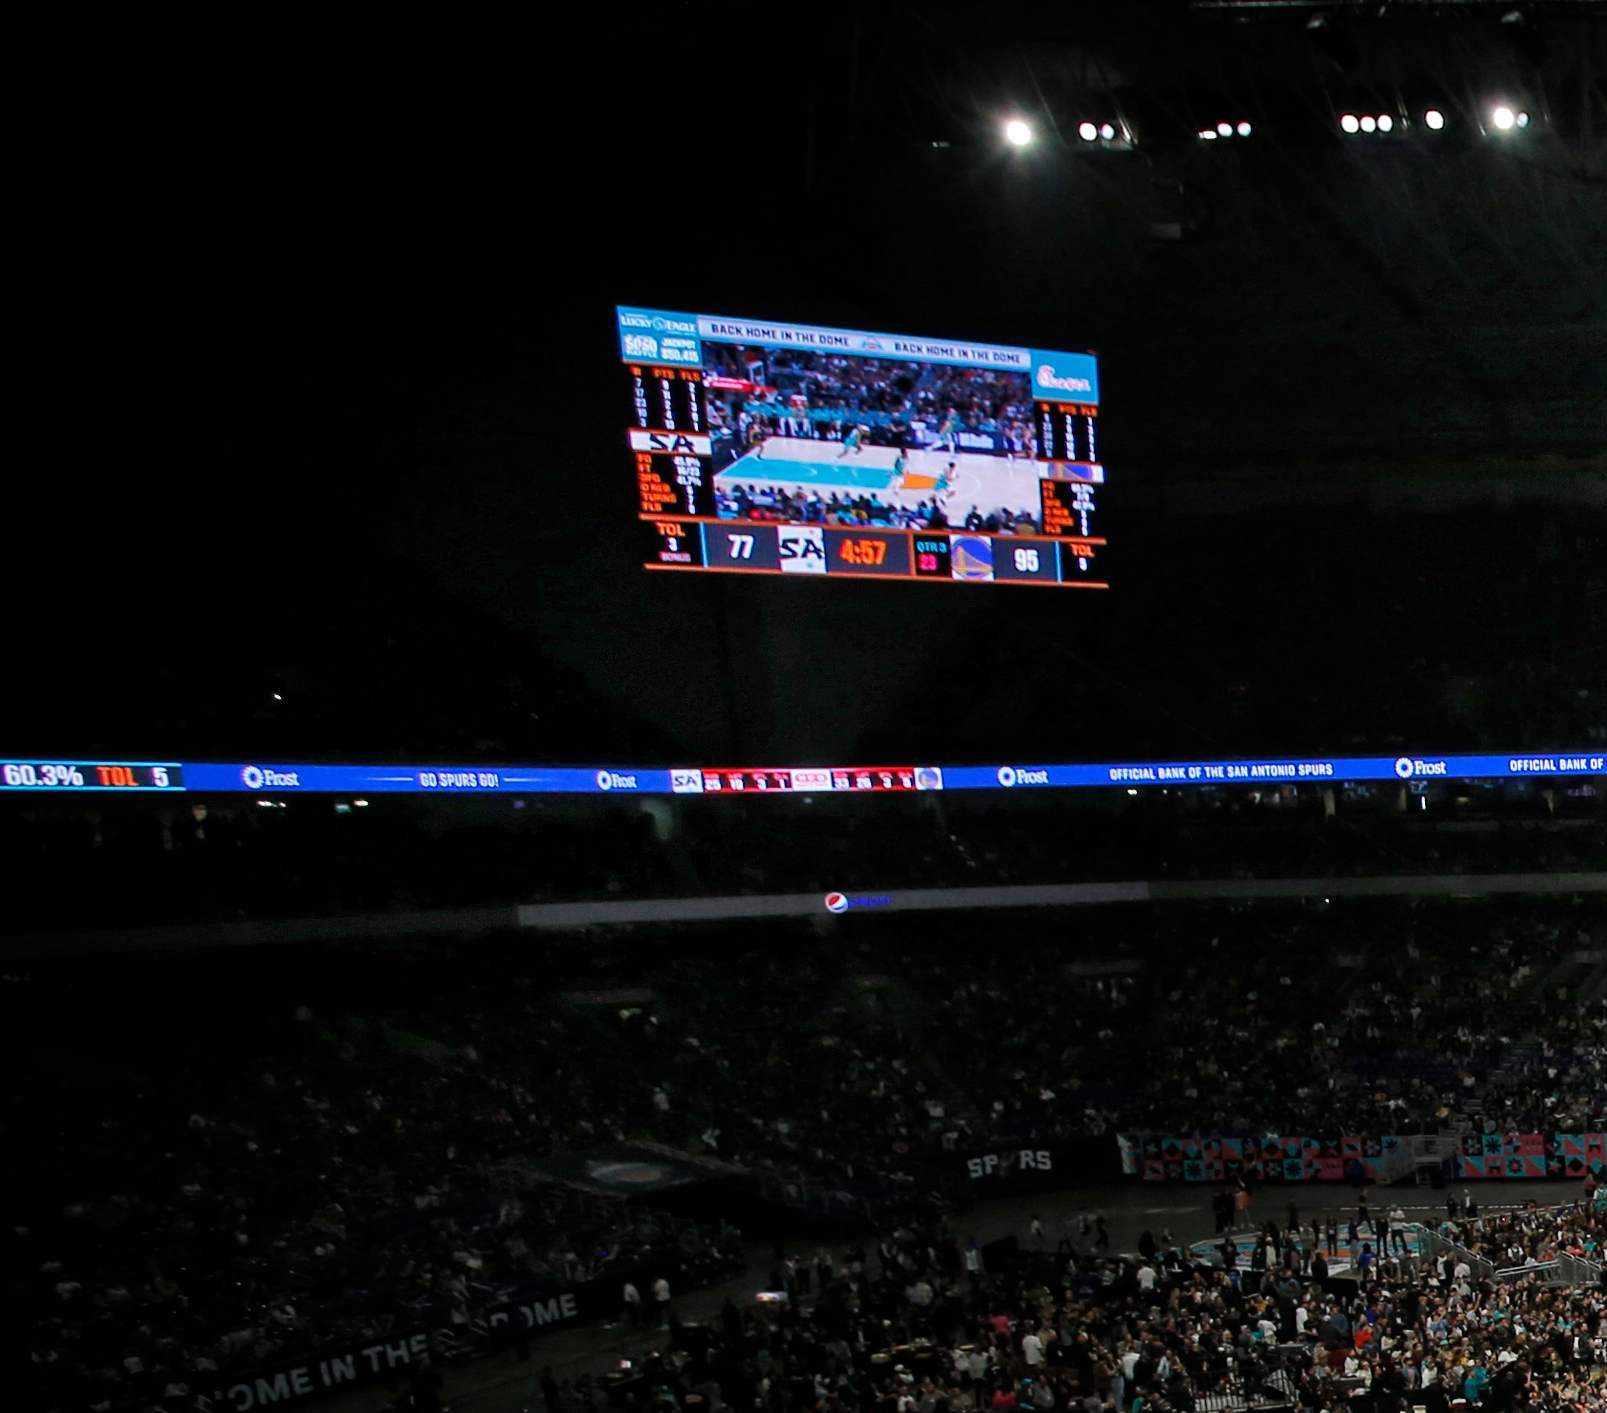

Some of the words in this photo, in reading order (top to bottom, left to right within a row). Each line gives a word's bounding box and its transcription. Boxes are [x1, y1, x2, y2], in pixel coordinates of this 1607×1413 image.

[711, 323, 743, 336] BACK
[746, 328, 777, 340] HOME
[781, 331, 793, 341] IN
[796, 332, 815, 343] THE
[819, 335, 849, 347] DOME
[894, 341, 923, 354] BACK
[927, 345, 955, 358] HOME
[958, 349, 968, 359] IN
[972, 350, 990, 361] THE
[993, 352, 1020, 364] DOME
[657, 523, 685, 536] TOL
[728, 534, 754, 559] 77
[781, 537, 825, 559] SA
[840, 539, 887, 564] 4:57
[1014, 548, 1039, 572] 95
[1110, 768, 1155, 781] OFFICIAL
[1158, 767, 1185, 779] BANK
[1187, 766, 1201, 779] OF
[1204, 766, 1224, 778] THE
[1227, 765, 1248, 778] SAN
[1251, 764, 1295, 777] ANTONIO
[1298, 763, 1333, 776] SPURS
[1415, 761, 1446, 775] Frost
[1510, 759, 1556, 772] OFFICIAL
[1560, 758, 1588, 770] BANK
[1591, 758, 1604, 770] OF
[3, 765, 84, 786] 60.3%
[97, 766, 139, 786] TOL
[151, 767, 169, 786] 5
[264, 769, 299, 786] Frost
[420, 773, 438, 787] GO
[439, 773, 477, 787] SPURS
[479, 773, 499, 787] GO!
[1017, 770, 1048, 784] Frost
[968, 1150, 1052, 1181] SPRS
[320, 1354, 357, 1389] IN
[363, 1333, 431, 1377] THE
